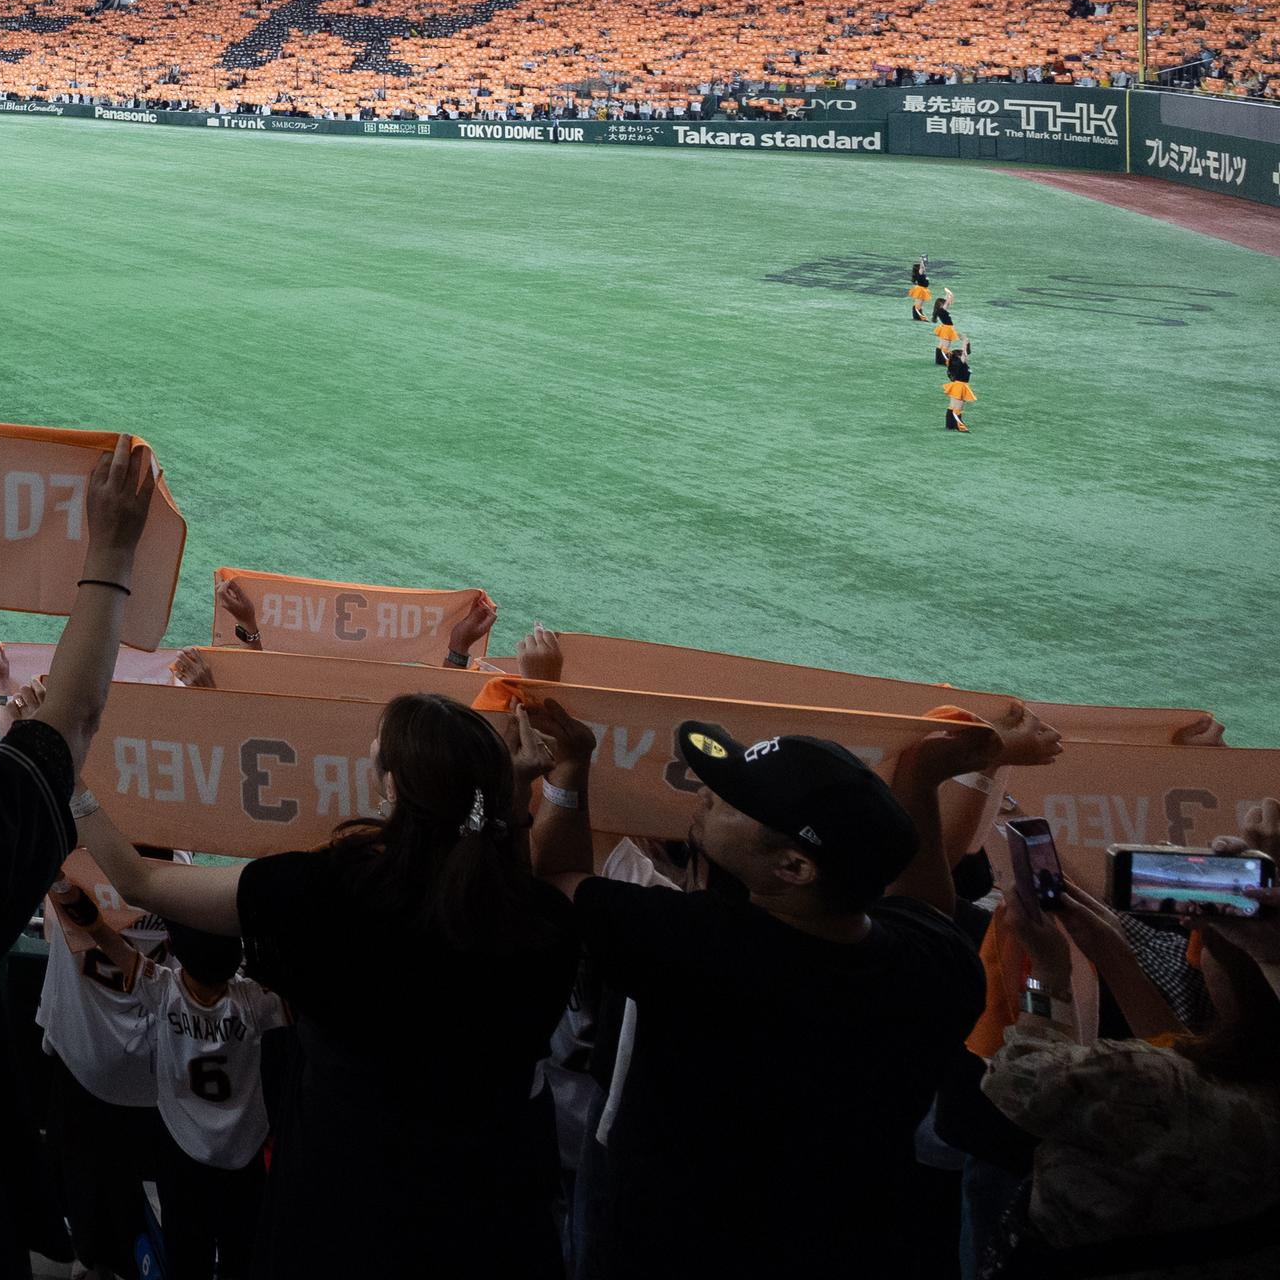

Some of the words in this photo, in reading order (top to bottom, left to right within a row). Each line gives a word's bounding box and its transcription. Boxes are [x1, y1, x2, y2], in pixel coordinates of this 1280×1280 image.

[902, 95, 1000, 114] 最先端の
[94, 106, 158, 123] Panasonic
[222, 115, 266, 130] Trunk
[1003, 98, 1119, 138] THK
[271, 121, 318, 130] SMBCグループ
[378, 123, 416, 132] DAZN.COM
[458, 124, 502, 138] TOKYO
[505, 125, 542, 140] DOME
[547, 127, 584, 141] TOUR
[608, 124, 665, 134] 水まわりって、
[926, 116, 1000, 137] 自働化
[608, 133, 655, 143] 大切だから
[672, 125, 756, 146] Takara
[760, 130, 881, 150] standard
[1005, 128, 1023, 138] The
[1026, 129, 1050, 139] Mark
[1052, 131, 1062, 140] of
[1063, 132, 1091, 142] Linear
[1092, 134, 1119, 146] Motion
[1145, 138, 1247, 186] プレミアム・モルツ
